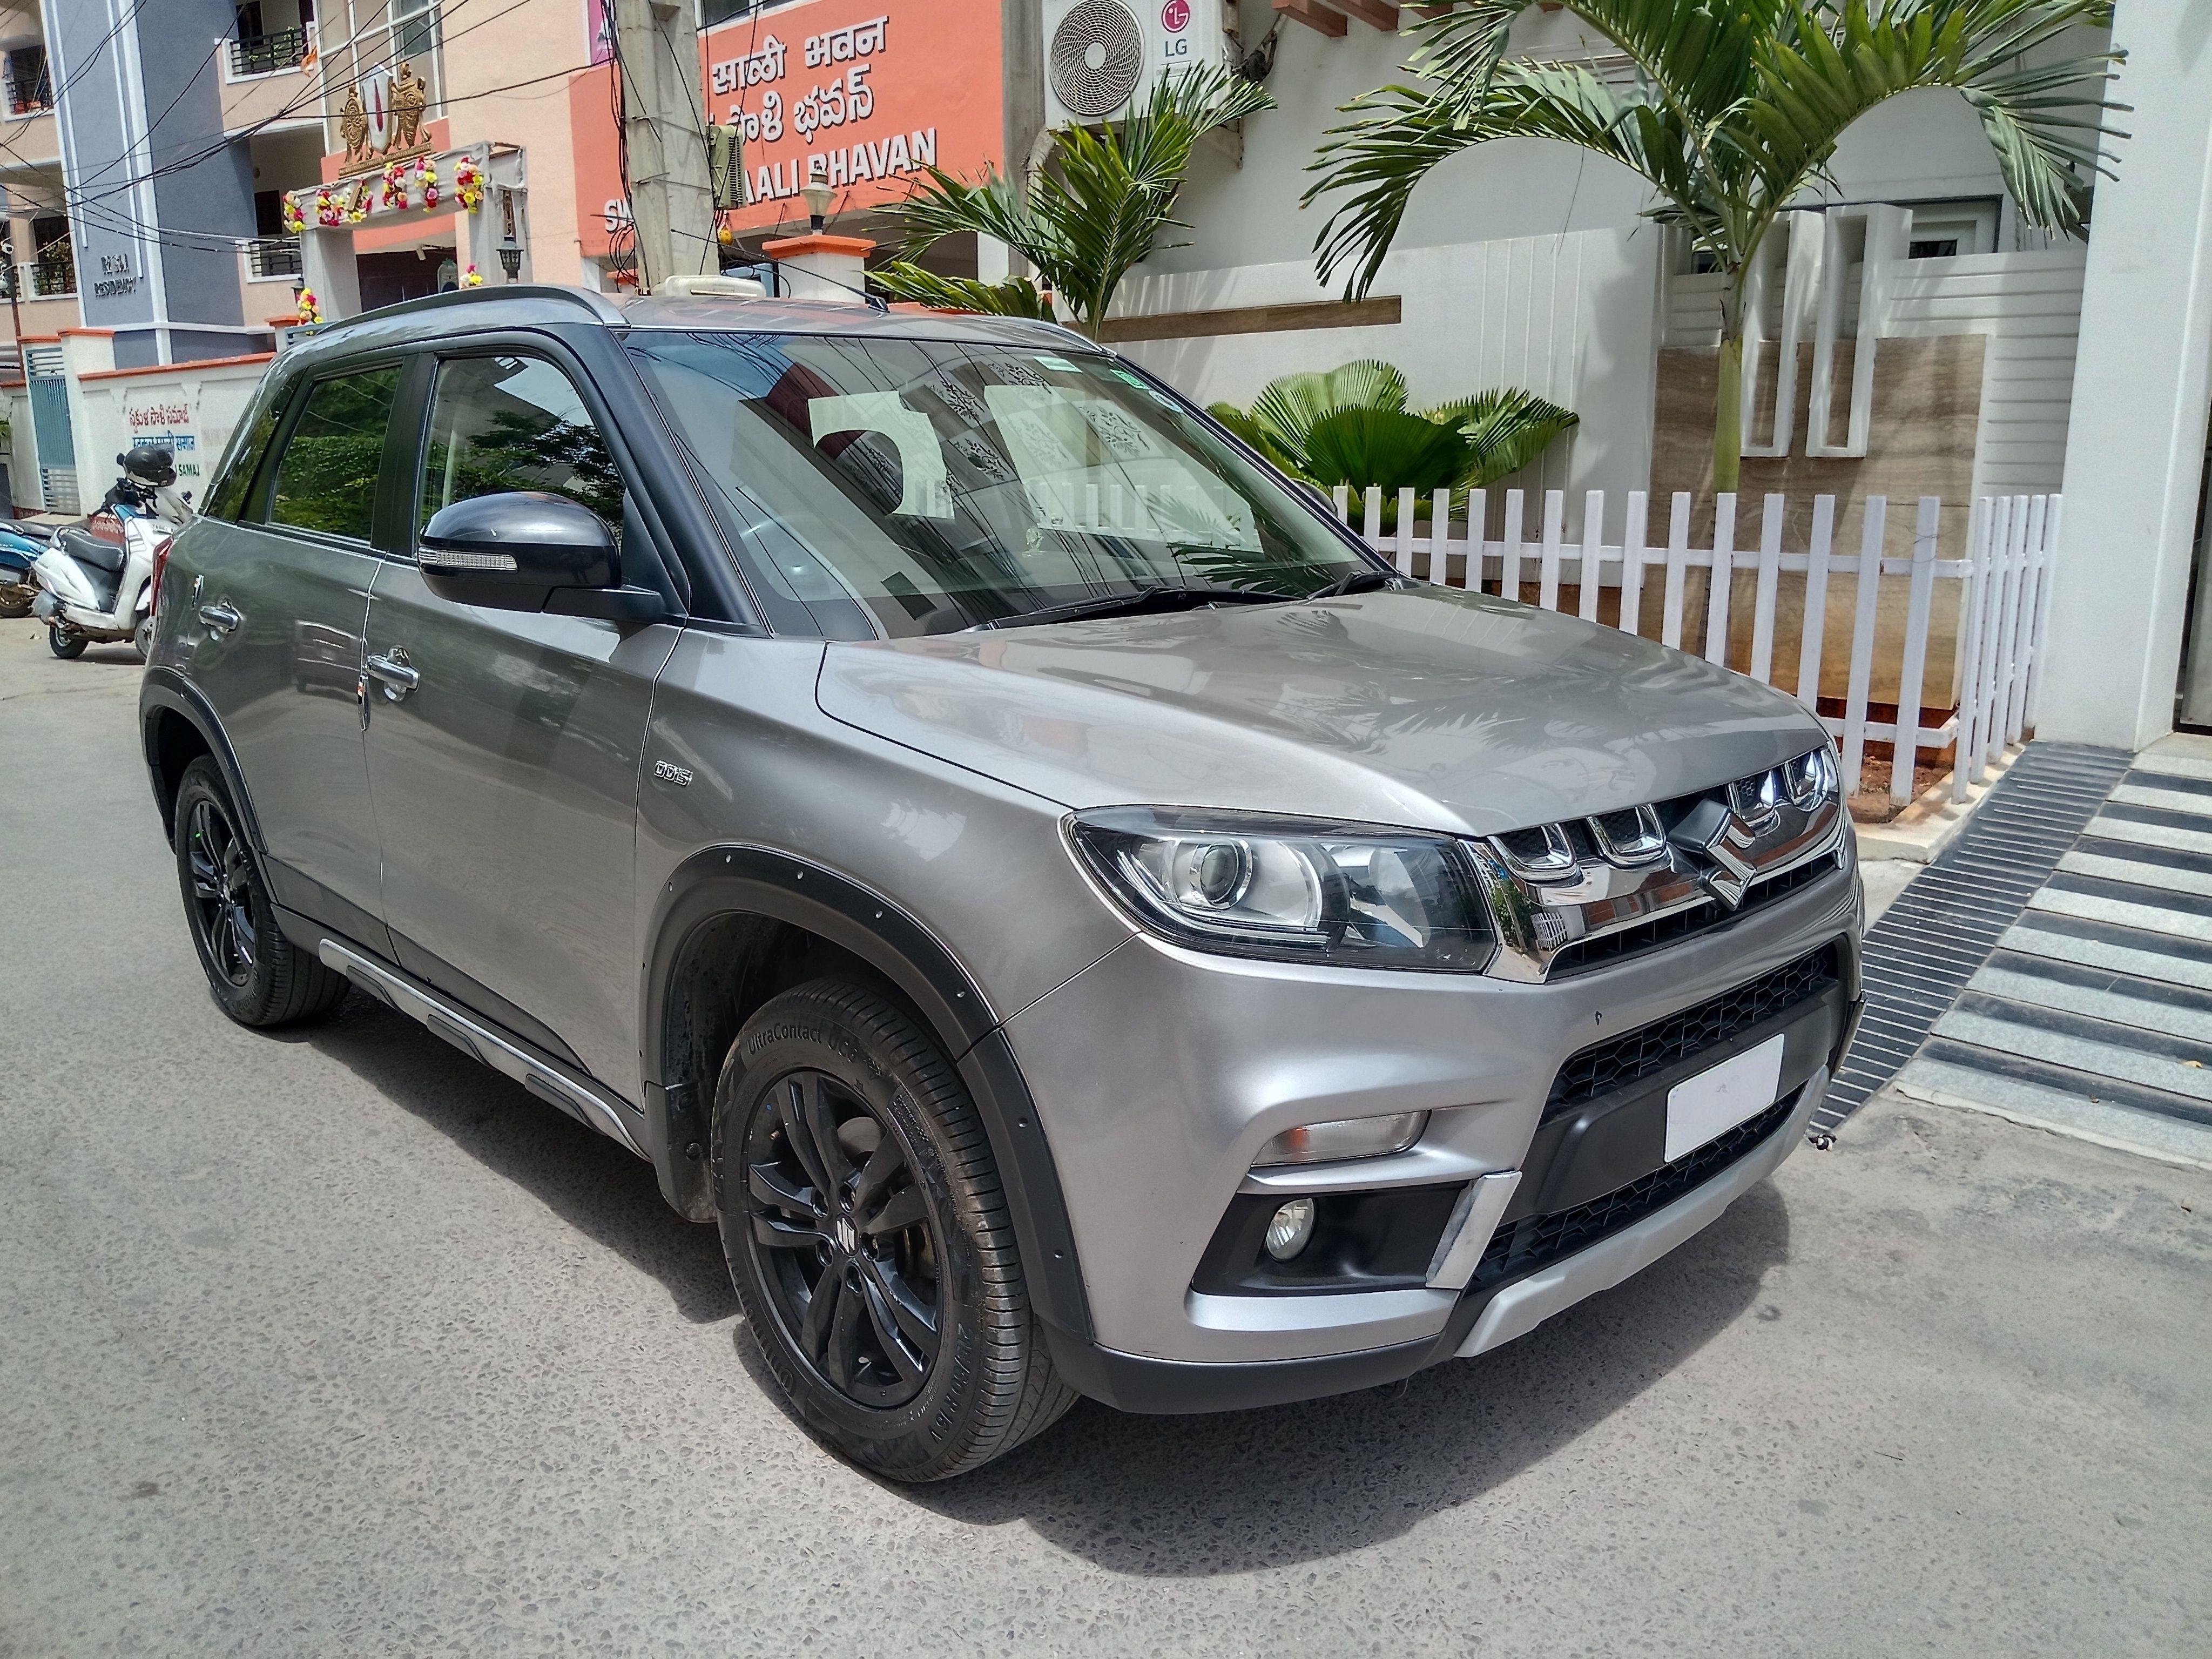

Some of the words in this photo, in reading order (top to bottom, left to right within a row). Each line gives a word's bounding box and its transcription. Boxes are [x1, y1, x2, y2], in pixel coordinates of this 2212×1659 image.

[712, 35, 787, 95] साळी
[805, 15, 889, 69] भवन
[1165, 38, 1188, 57] LG
[794, 63, 874, 143] భవన్
[808, 127, 937, 188] BHAVAN
[176, 436, 195, 451] समाज
[179, 464, 200, 476] SAMAJ
[747, 1021, 822, 1056] UltraContact
